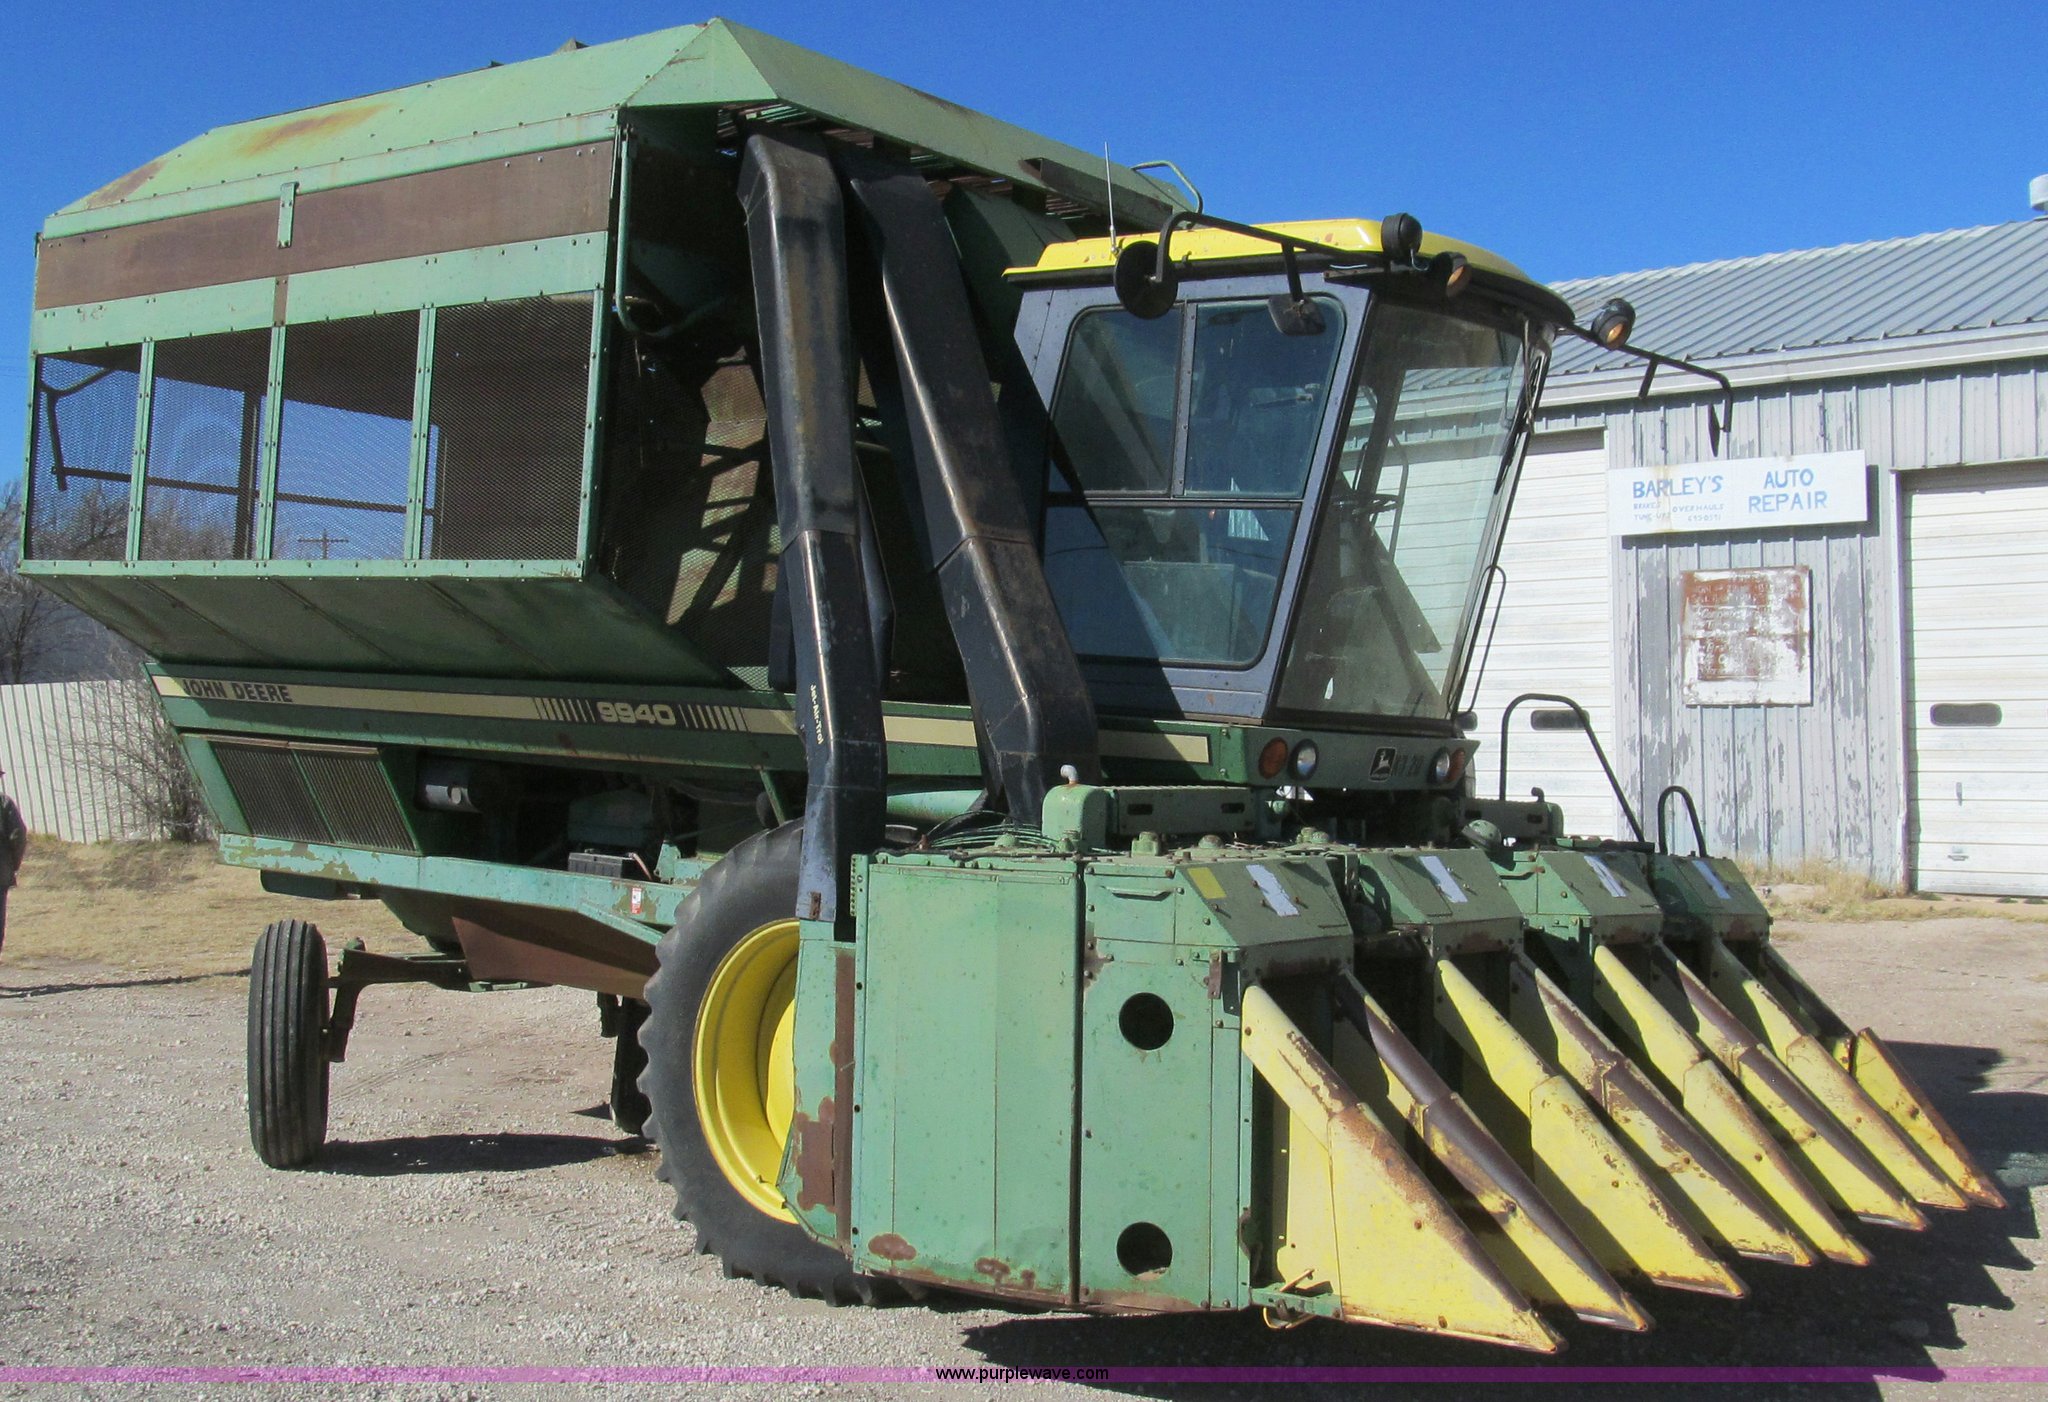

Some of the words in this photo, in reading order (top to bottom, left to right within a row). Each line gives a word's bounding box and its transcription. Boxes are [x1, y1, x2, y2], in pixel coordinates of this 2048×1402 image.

[1633, 475, 1724, 499] BARLEY'S
[1763, 468, 1814, 489] AUTO
[1671, 503, 1725, 513] OVERHAULS
[1748, 490, 1828, 513] REPAIR
[183, 679, 227, 699] JOHN
[231, 682, 293, 703] DEERE
[596, 701, 676, 726] 9940
